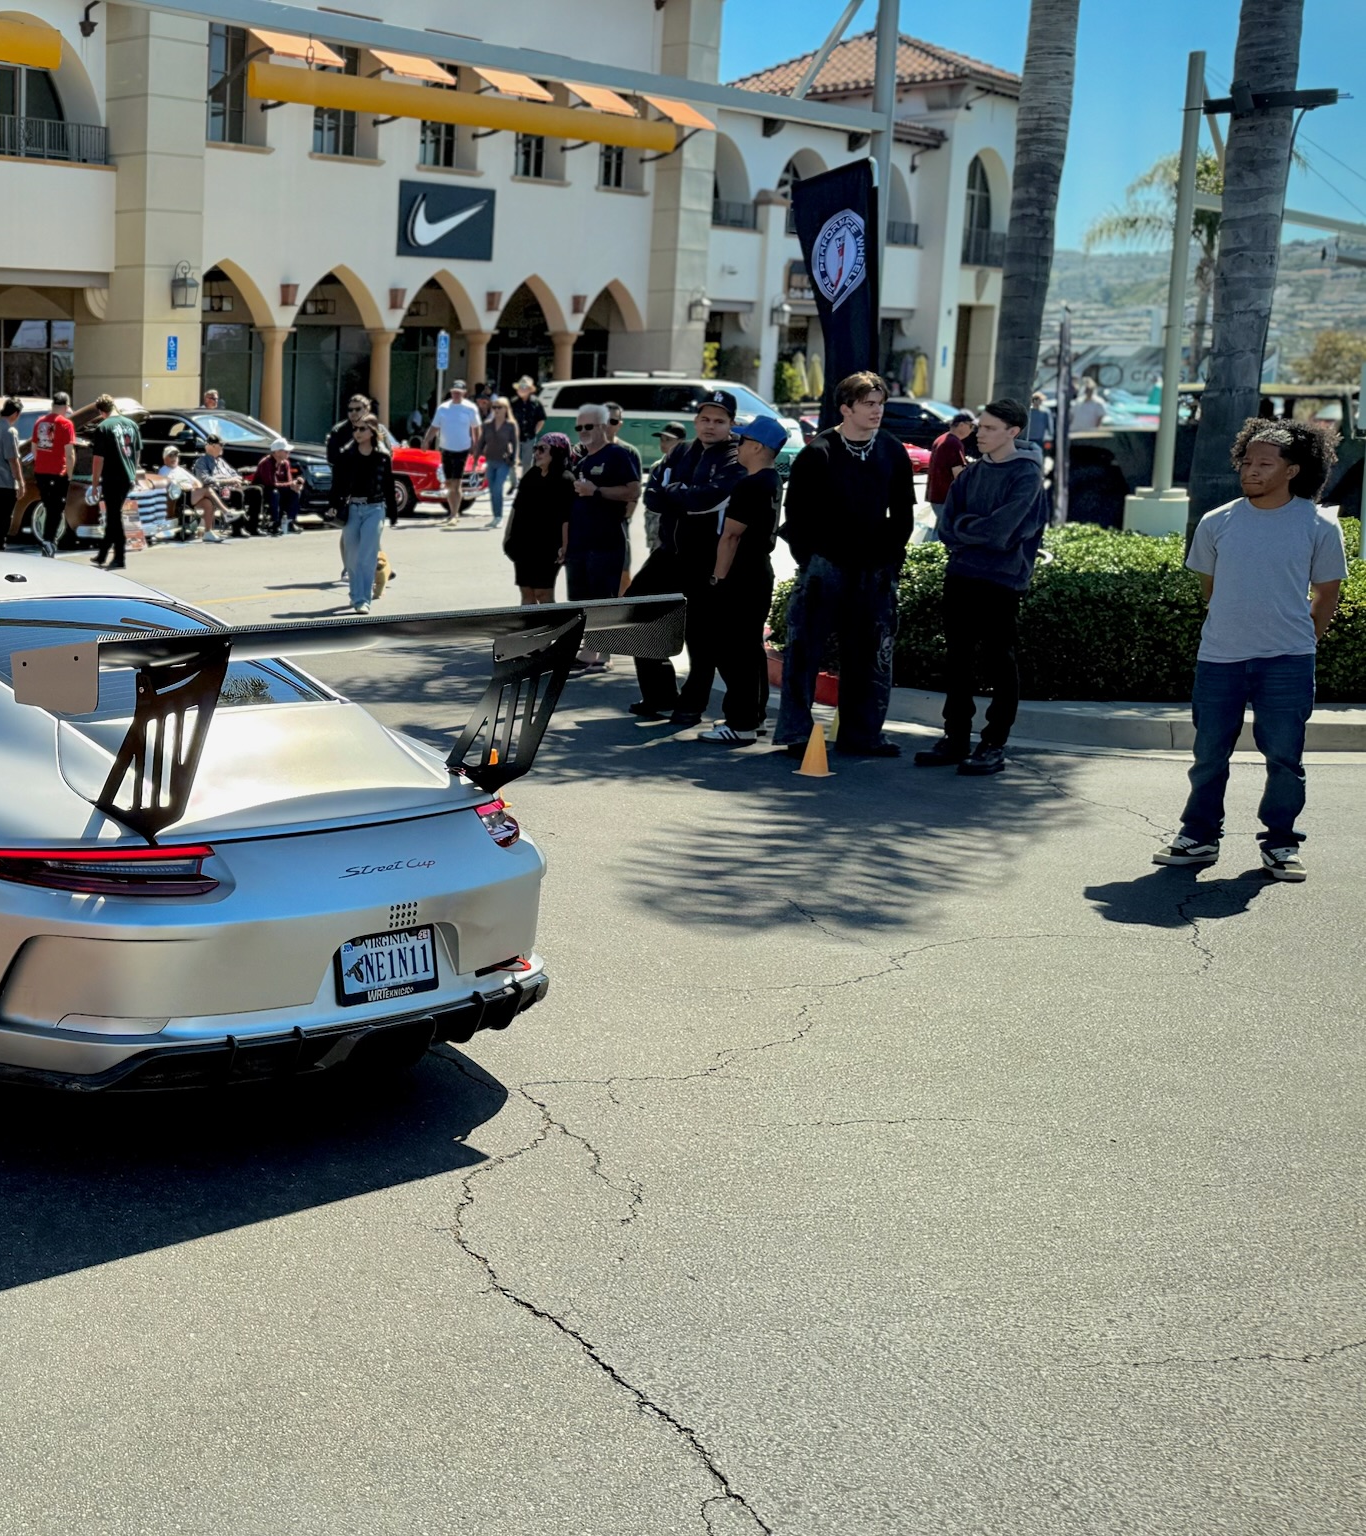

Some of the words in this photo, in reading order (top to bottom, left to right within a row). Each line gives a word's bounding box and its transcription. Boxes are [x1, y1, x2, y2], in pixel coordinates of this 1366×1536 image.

[844, 234, 866, 288] WHEELS
[338, 860, 403, 879] Street
[406, 858, 436, 868] Cup
[363, 931, 409, 949] VIRGINIA
[363, 943, 430, 985] NE1N11
